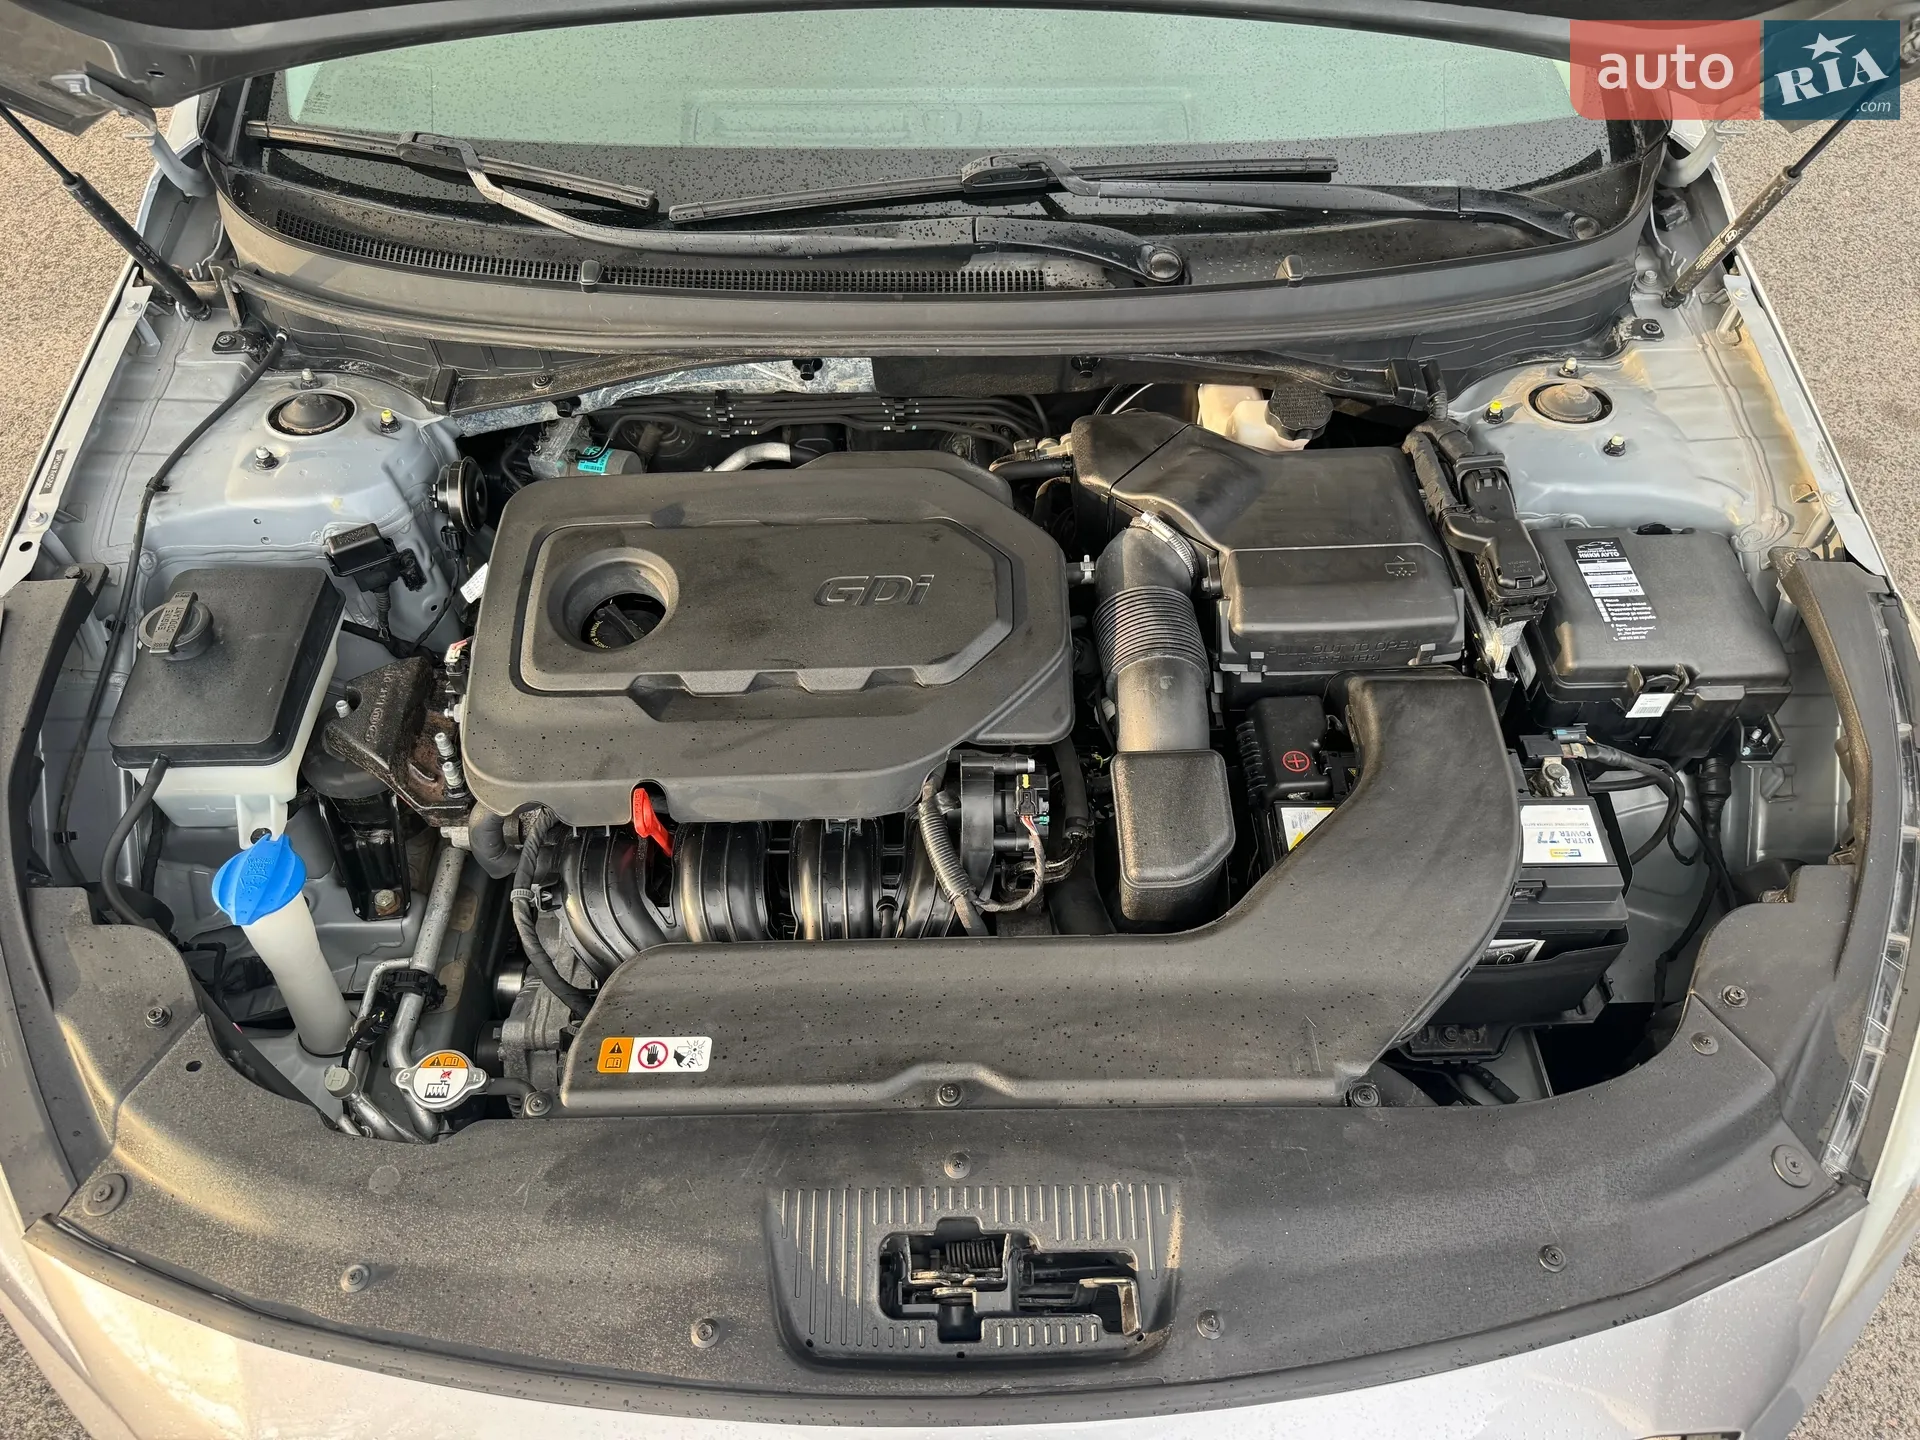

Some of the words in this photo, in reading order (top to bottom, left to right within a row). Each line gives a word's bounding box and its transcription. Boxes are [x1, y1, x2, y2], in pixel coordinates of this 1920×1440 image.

[813, 574, 935, 607] GDi
[1312, 643, 1346, 656] OUT
[1350, 643, 1369, 653] TO
[1374, 640, 1420, 652] OPEN
